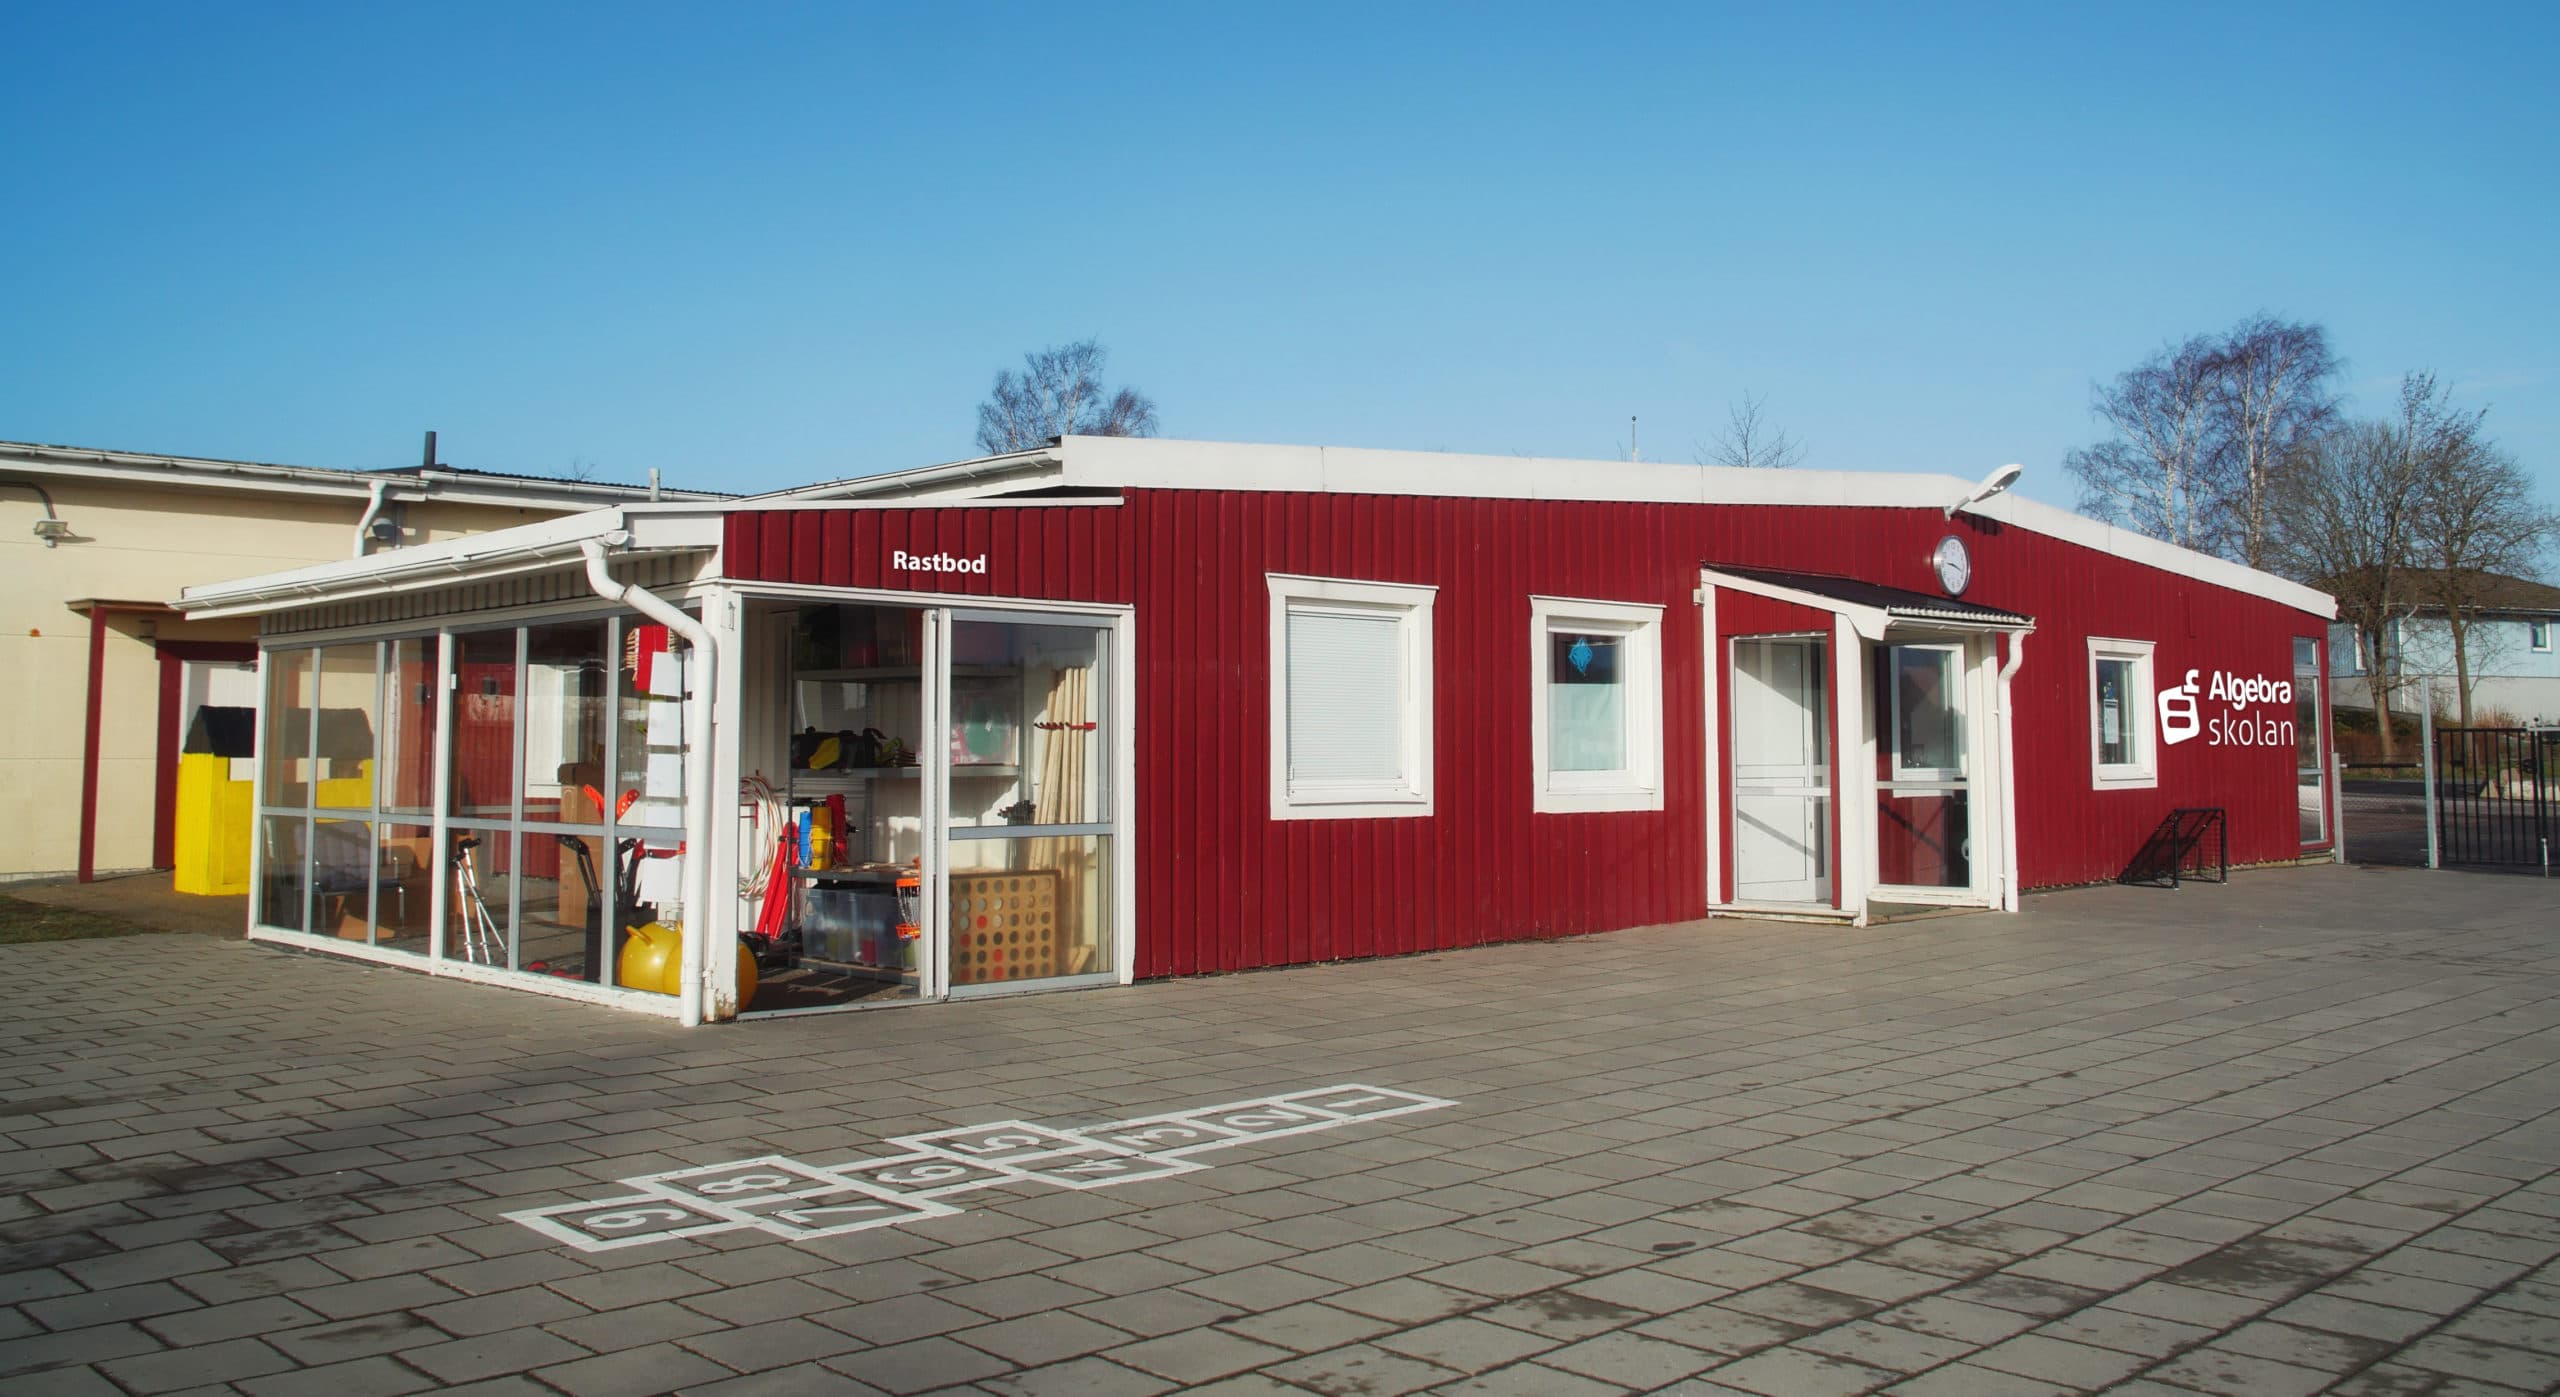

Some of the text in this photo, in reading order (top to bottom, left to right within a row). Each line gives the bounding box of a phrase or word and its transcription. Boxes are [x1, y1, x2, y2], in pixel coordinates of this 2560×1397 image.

[893, 550, 986, 574] Rastbod
[2208, 670, 2292, 711] Algebra
[2208, 708, 2295, 746] skolan
[1323, 1095, 1387, 1108] 1
[1223, 1108, 1307, 1127] 2
[950, 1134, 1040, 1154] 5
[1111, 1127, 1198, 1146] 3
[877, 1164, 967, 1183] 6
[1052, 1158, 1129, 1173] 4
[697, 1174, 791, 1194] 8
[583, 1208, 688, 1229] 9
[771, 1205, 888, 1223] 7
